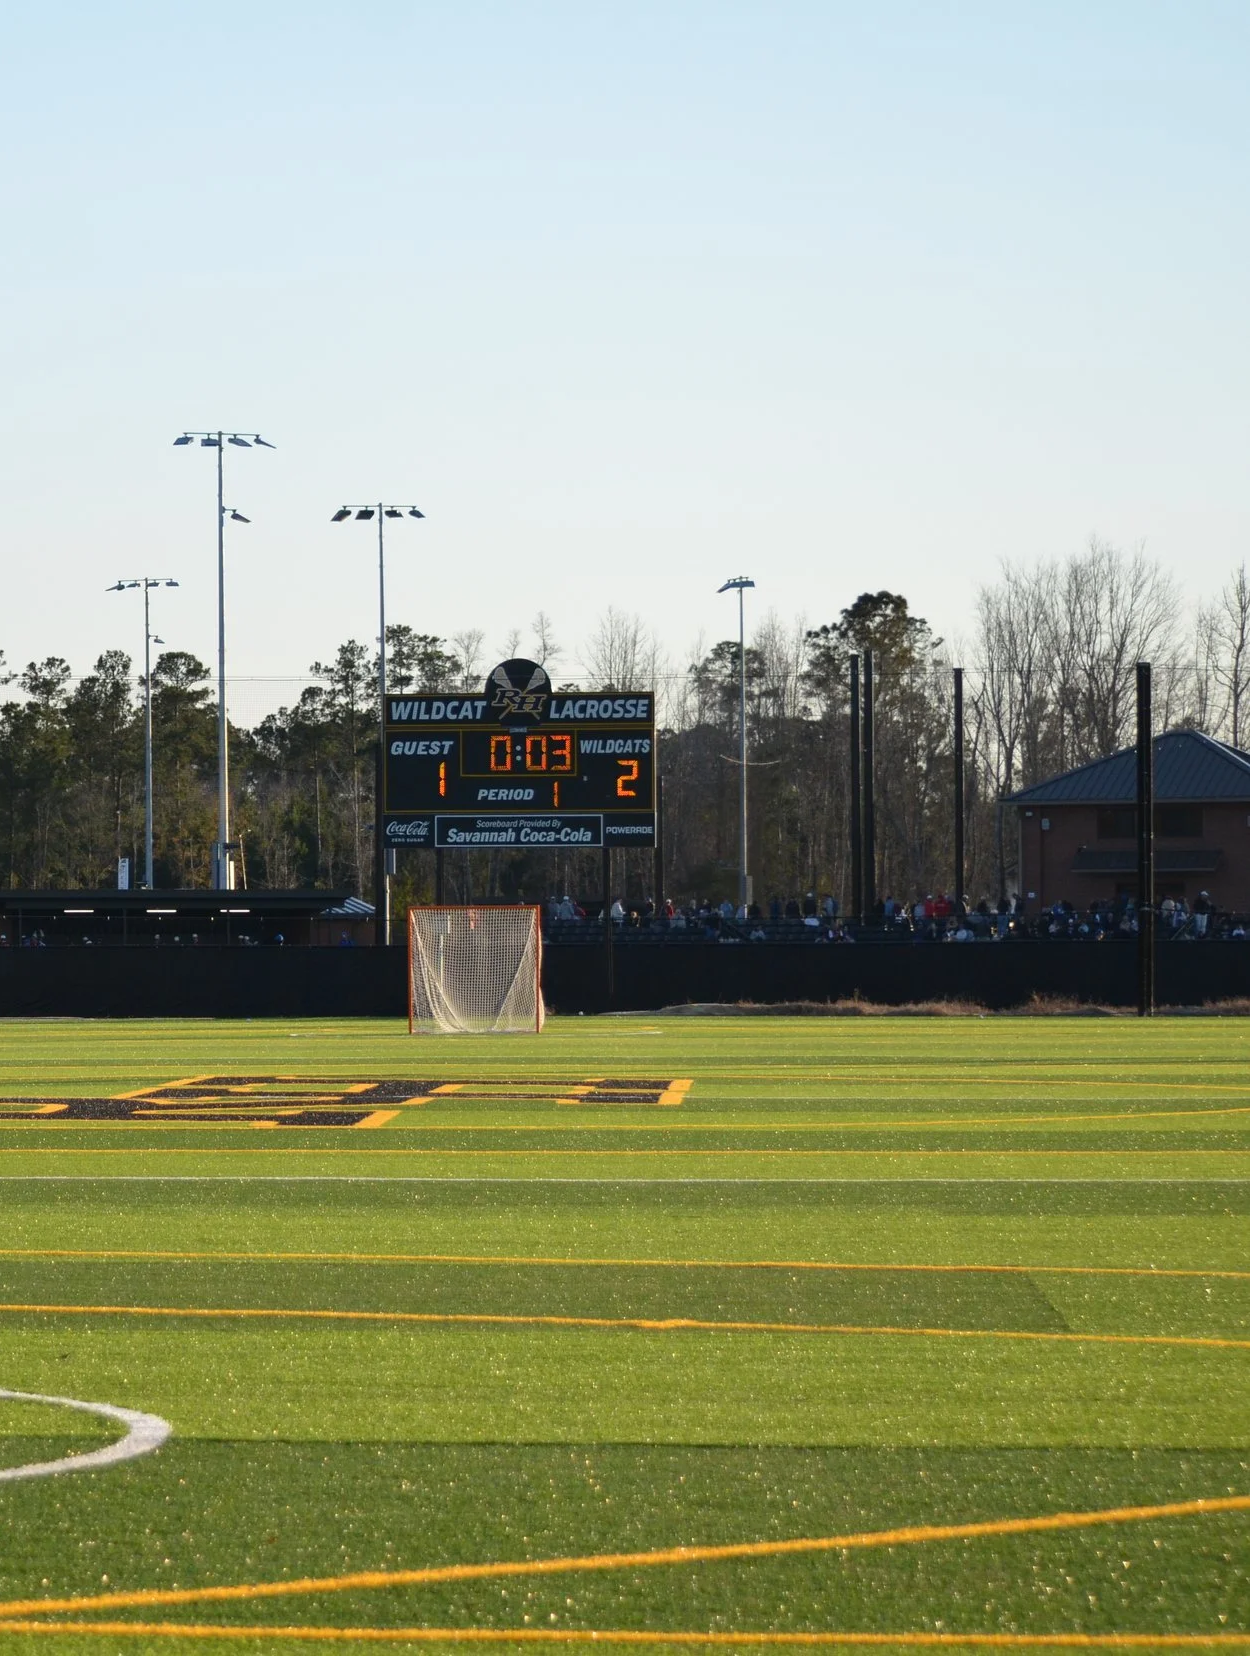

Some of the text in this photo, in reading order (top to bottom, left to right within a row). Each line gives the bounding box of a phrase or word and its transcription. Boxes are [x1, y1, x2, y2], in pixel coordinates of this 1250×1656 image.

[391, 699, 649, 720] WILDCAT LACROSSE
[390, 741, 454, 756] GUEST
[490, 735, 571, 771] 0:03
[579, 739, 651, 754] WILDCATS
[438, 761, 446, 797] 1
[616, 759, 639, 796] 2
[477, 788, 535, 801] PERIOD
[553, 780, 559, 808] 1
[476, 819, 562, 830] Scoreboard Provided By
[605, 826, 653, 834] POWERADE
[447, 827, 592, 843] Savannah Coca-Cola
